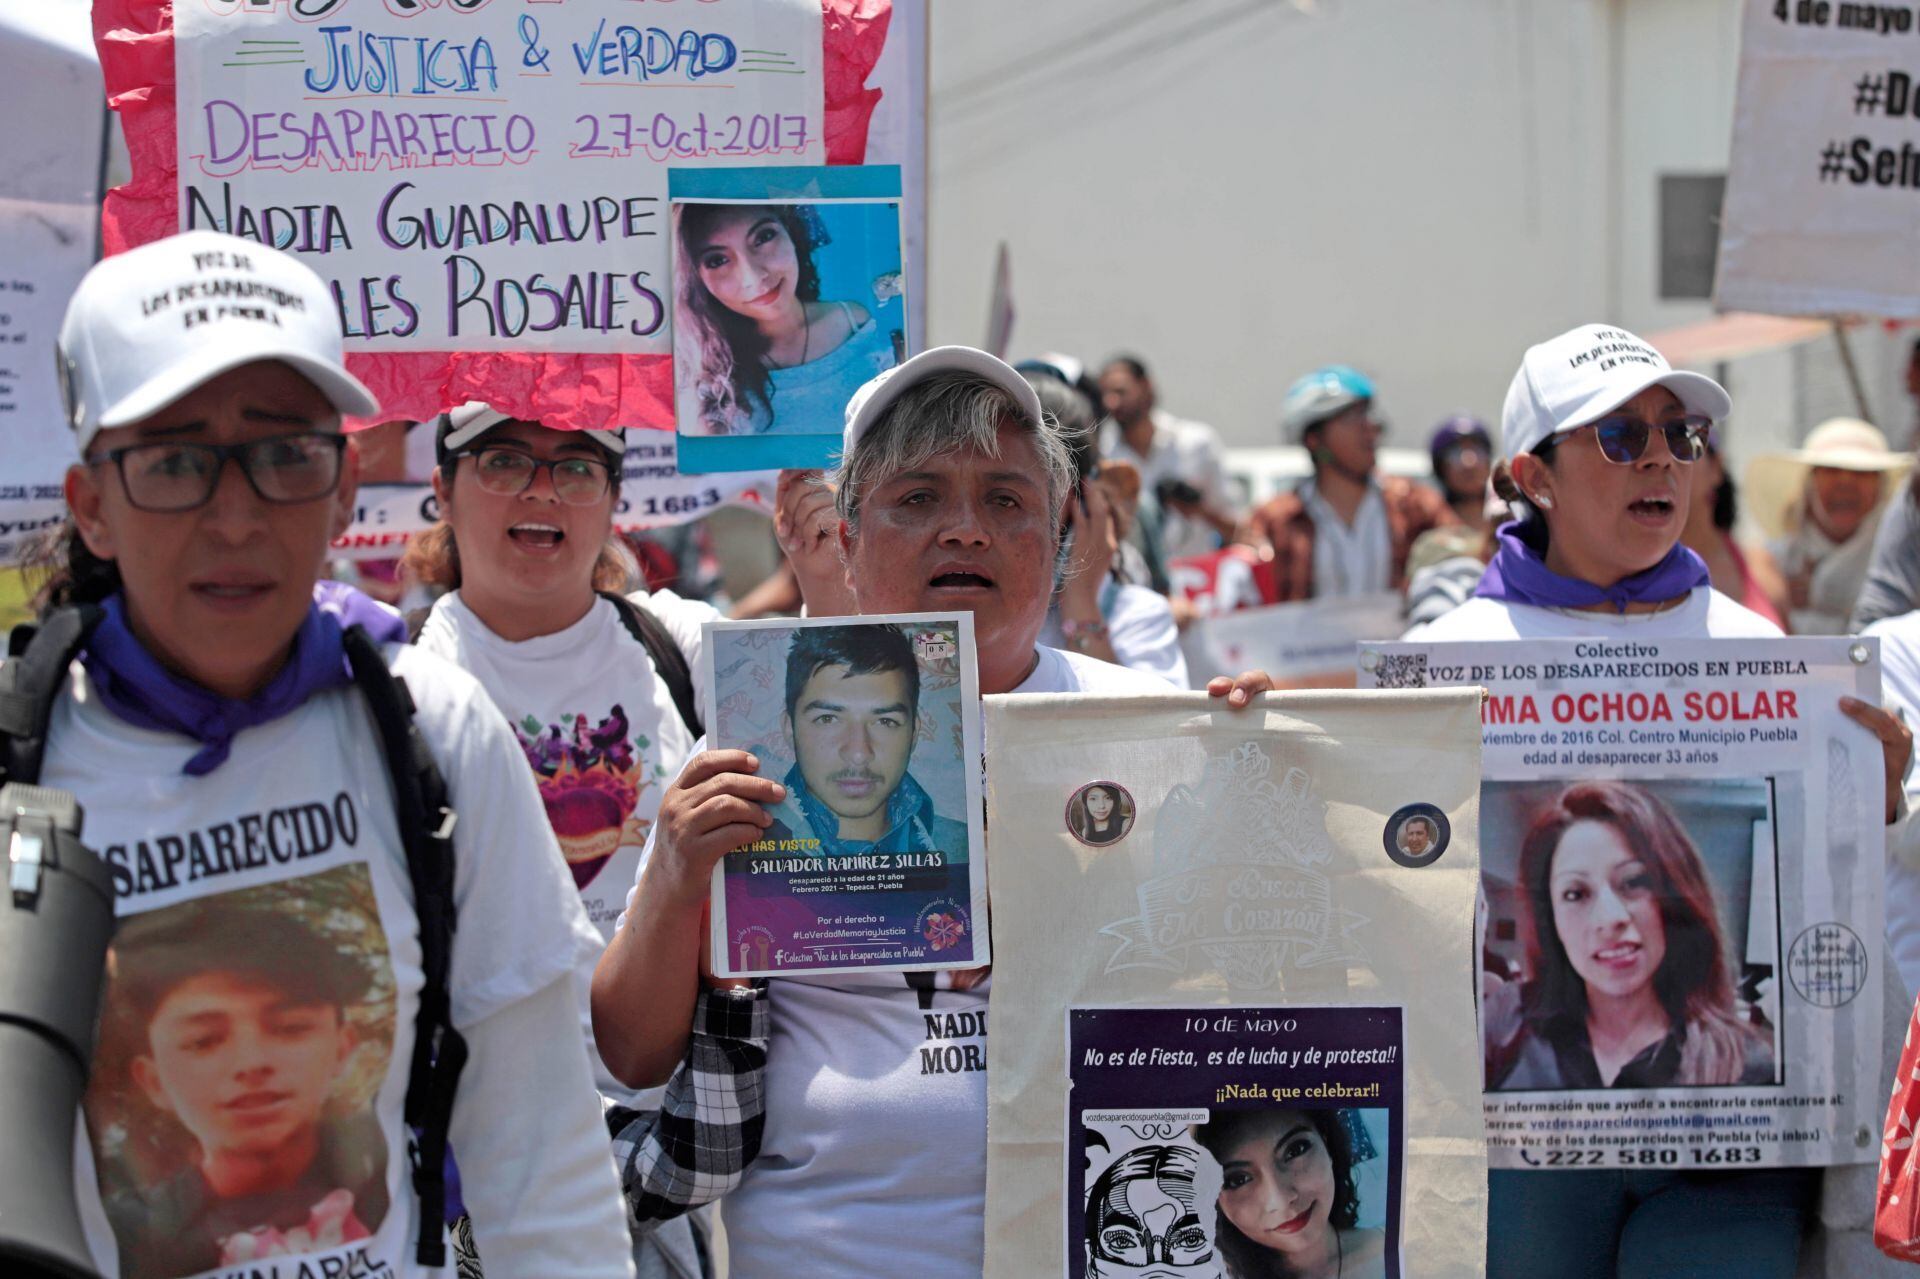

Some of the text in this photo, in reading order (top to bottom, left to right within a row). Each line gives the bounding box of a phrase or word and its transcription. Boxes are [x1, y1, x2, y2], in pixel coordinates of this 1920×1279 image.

[304, 26, 498, 97] JUSTICIA
[518, 13, 550, 72] &
[185, 182, 658, 253] NADIA GUADALUPE
[444, 254, 665, 339] ROSALES
[1575, 643, 1659, 658] Colectivo
[1429, 660, 1808, 681] VOZ DE LOS DESAPARECIDOS EN PUEBLA
[1551, 691, 1673, 724] OCHOA
[1683, 690, 1799, 722] SOLAR
[1482, 726, 1798, 745] viembre de 2016 Col. Centro Municipio Puebla
[1523, 749, 1719, 767] edad al desaparecer 33 años
[104, 791, 359, 899] SAPARECIDO
[751, 852, 943, 875] SALVADOR RAMÍREZ SILLAS
[847, 875, 865, 883] edad
[866, 874, 877, 882] de
[877, 873, 886, 881] 21
[887, 873, 905, 881] años
[792, 886, 820, 894] Febrero
[821, 885, 838, 893] 2021
[878, 882, 903, 890] Puebla
[818, 916, 832, 925] Por
[835, 916, 842, 924] el
[844, 915, 877, 924] derecho
[784, 951, 813, 963] Colectivo
[831, 951, 838, 960] de
[840, 950, 849, 960] los
[850, 947, 893, 964] desaparecidos
[894, 951, 901, 959] en
[923, 1010, 988, 1040] NADI
[1184, 1017, 1208, 1033] 10
[919, 1044, 988, 1075] MOR
[1084, 1046, 1397, 1069] No es de Fiesta, es de lucha y de protesta!!
[1216, 1083, 1380, 1103] ¡¡Nada que celebrar!!
[1587, 1100, 1611, 1113] que
[1085, 1112, 1206, 1123] vozdesaparecidospuebla@gmail.com
[1546, 1135, 1561, 1146] de
[1566, 1135, 1585, 1145] los
[1589, 1133, 1685, 1147] desaparecidos
[1691, 1134, 1704, 1144] en
[1708, 1131, 1751, 1143] Puebla
[1546, 1147, 1761, 1165] 222 580 1683
